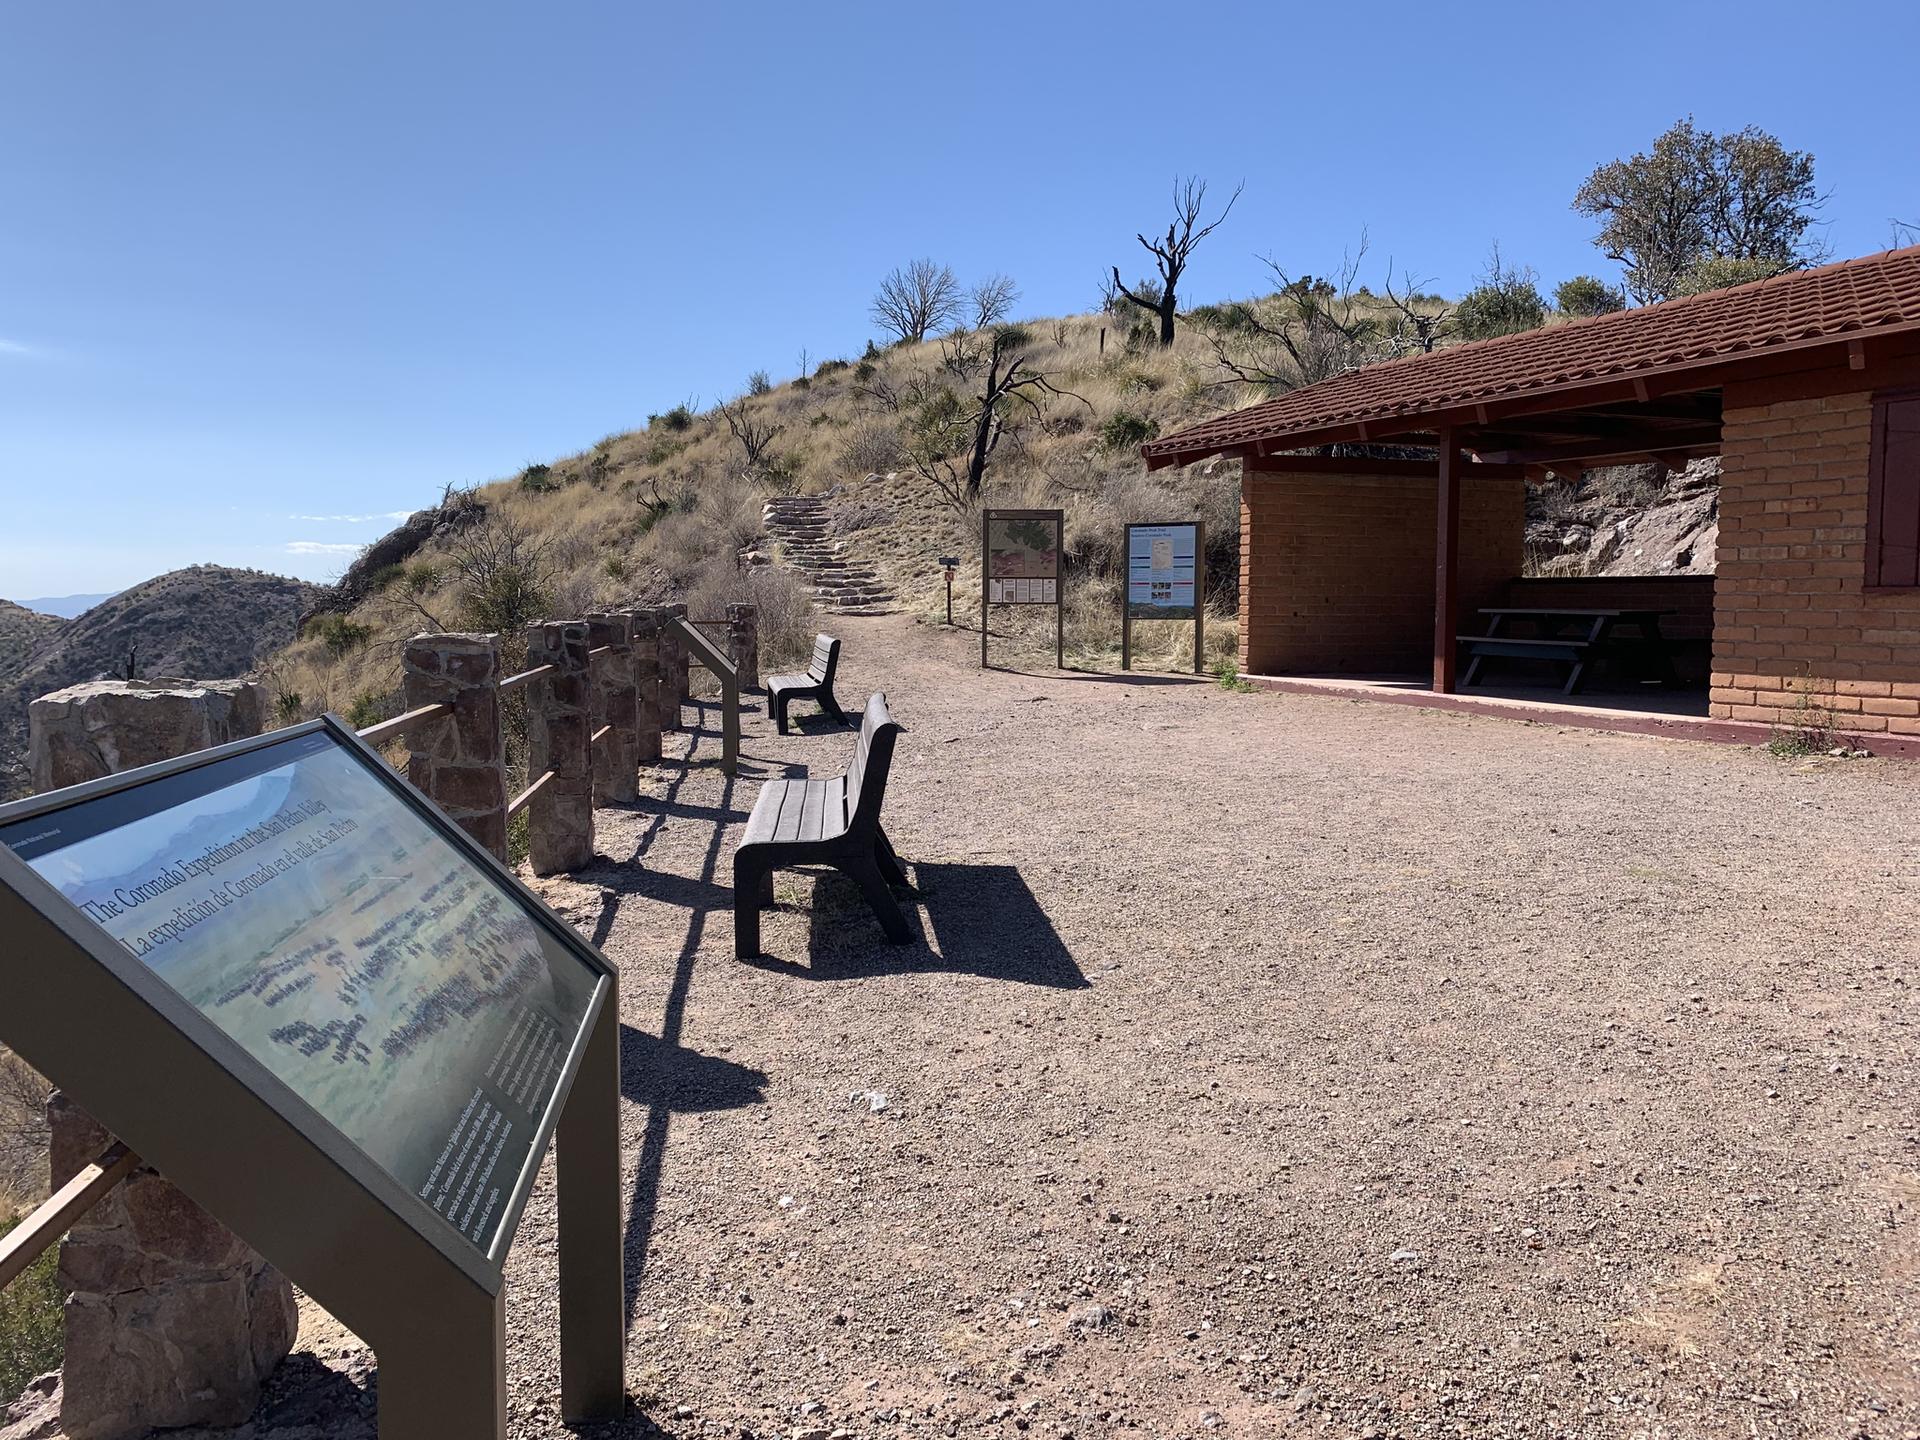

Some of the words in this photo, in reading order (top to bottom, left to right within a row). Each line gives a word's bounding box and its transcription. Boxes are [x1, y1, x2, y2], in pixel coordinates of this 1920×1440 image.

[329, 818, 359, 836] Pedro
[309, 835, 327, 850] de
[317, 829, 337, 844] San
[282, 848, 300, 865] el
[293, 840, 318, 859] valle
[80, 900, 123, 923] The
[114, 867, 186, 907] Coronado
[175, 843, 243, 878] Expedition
[231, 834, 254, 850] in
[246, 827, 270, 844] the
[259, 820, 287, 837] San
[275, 809, 307, 829] Pedro
[298, 799, 331, 819] Valley
[273, 858, 291, 872] en
[223, 862, 279, 898] Coronado
[209, 889, 234, 907] de
[148, 898, 219, 943] expedición
[120, 938, 155, 957] La
